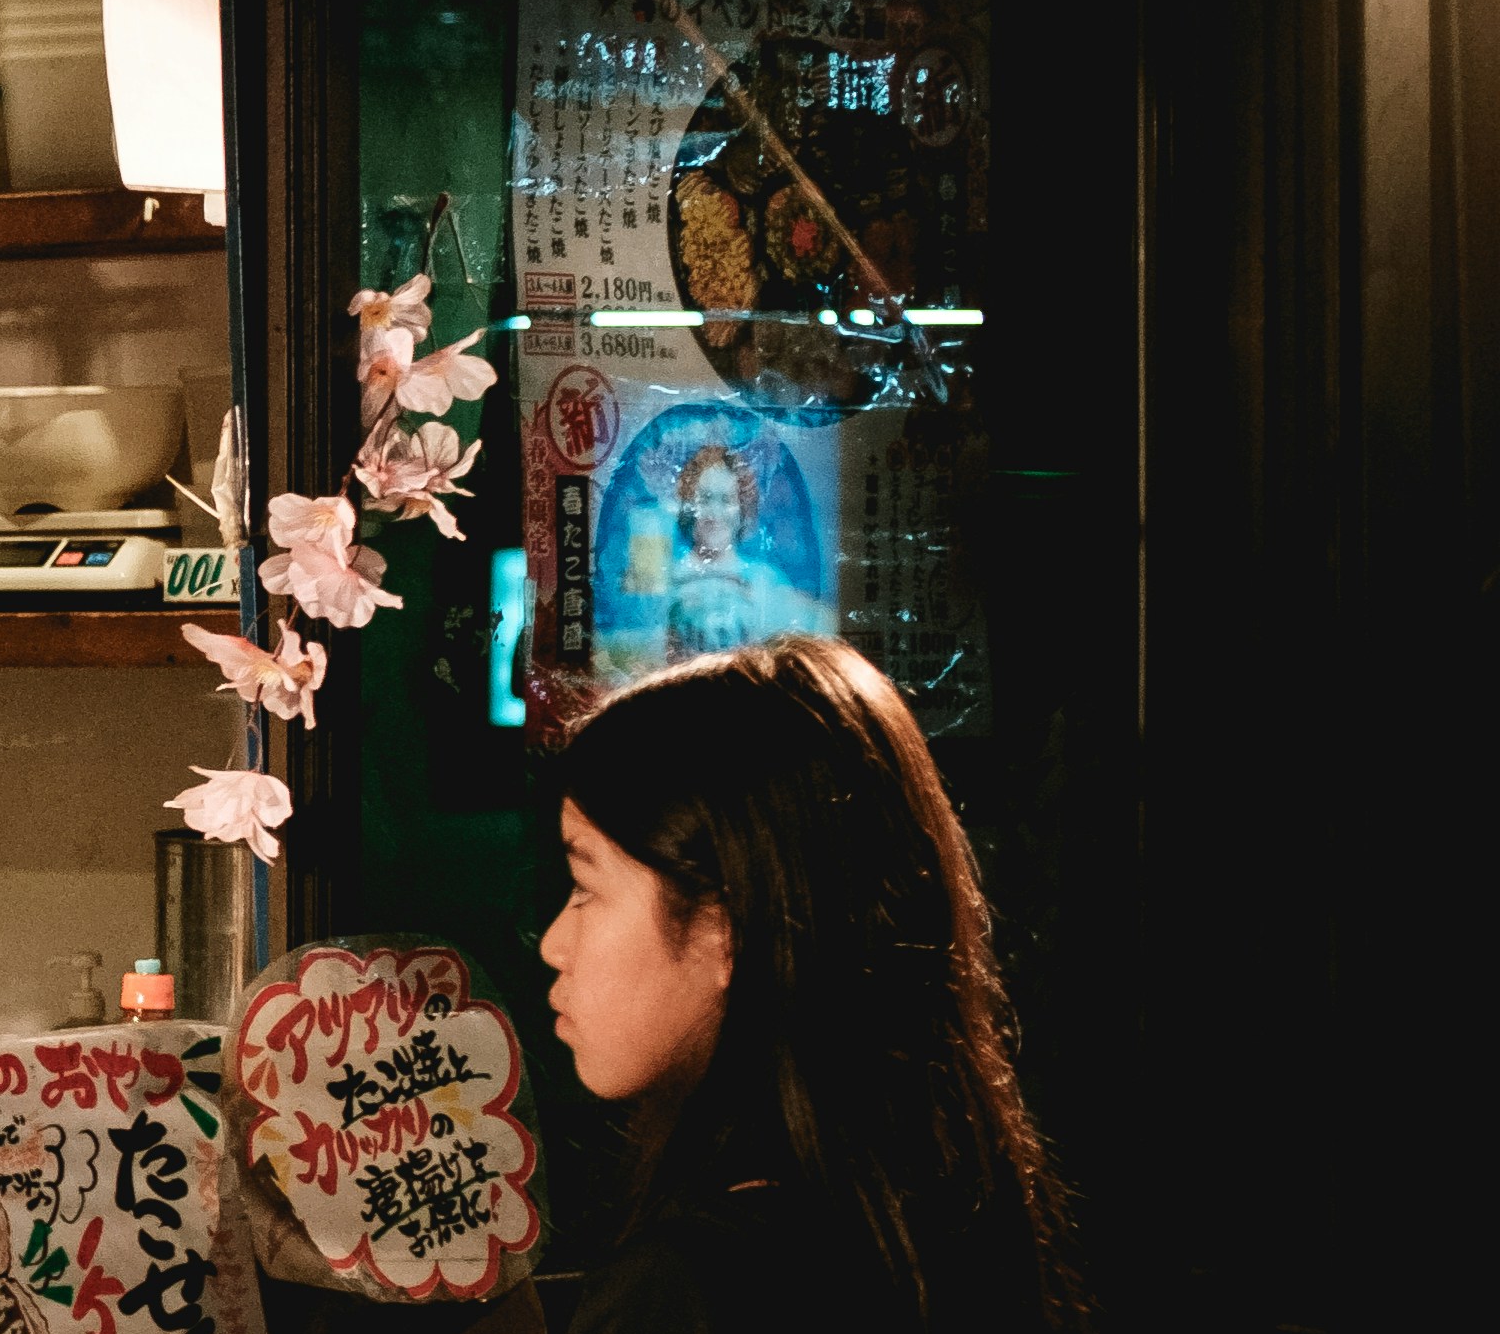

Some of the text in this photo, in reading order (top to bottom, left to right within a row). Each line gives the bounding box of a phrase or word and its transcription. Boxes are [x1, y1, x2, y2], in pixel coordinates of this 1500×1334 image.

[266, 969, 451, 1085] アツアツの
